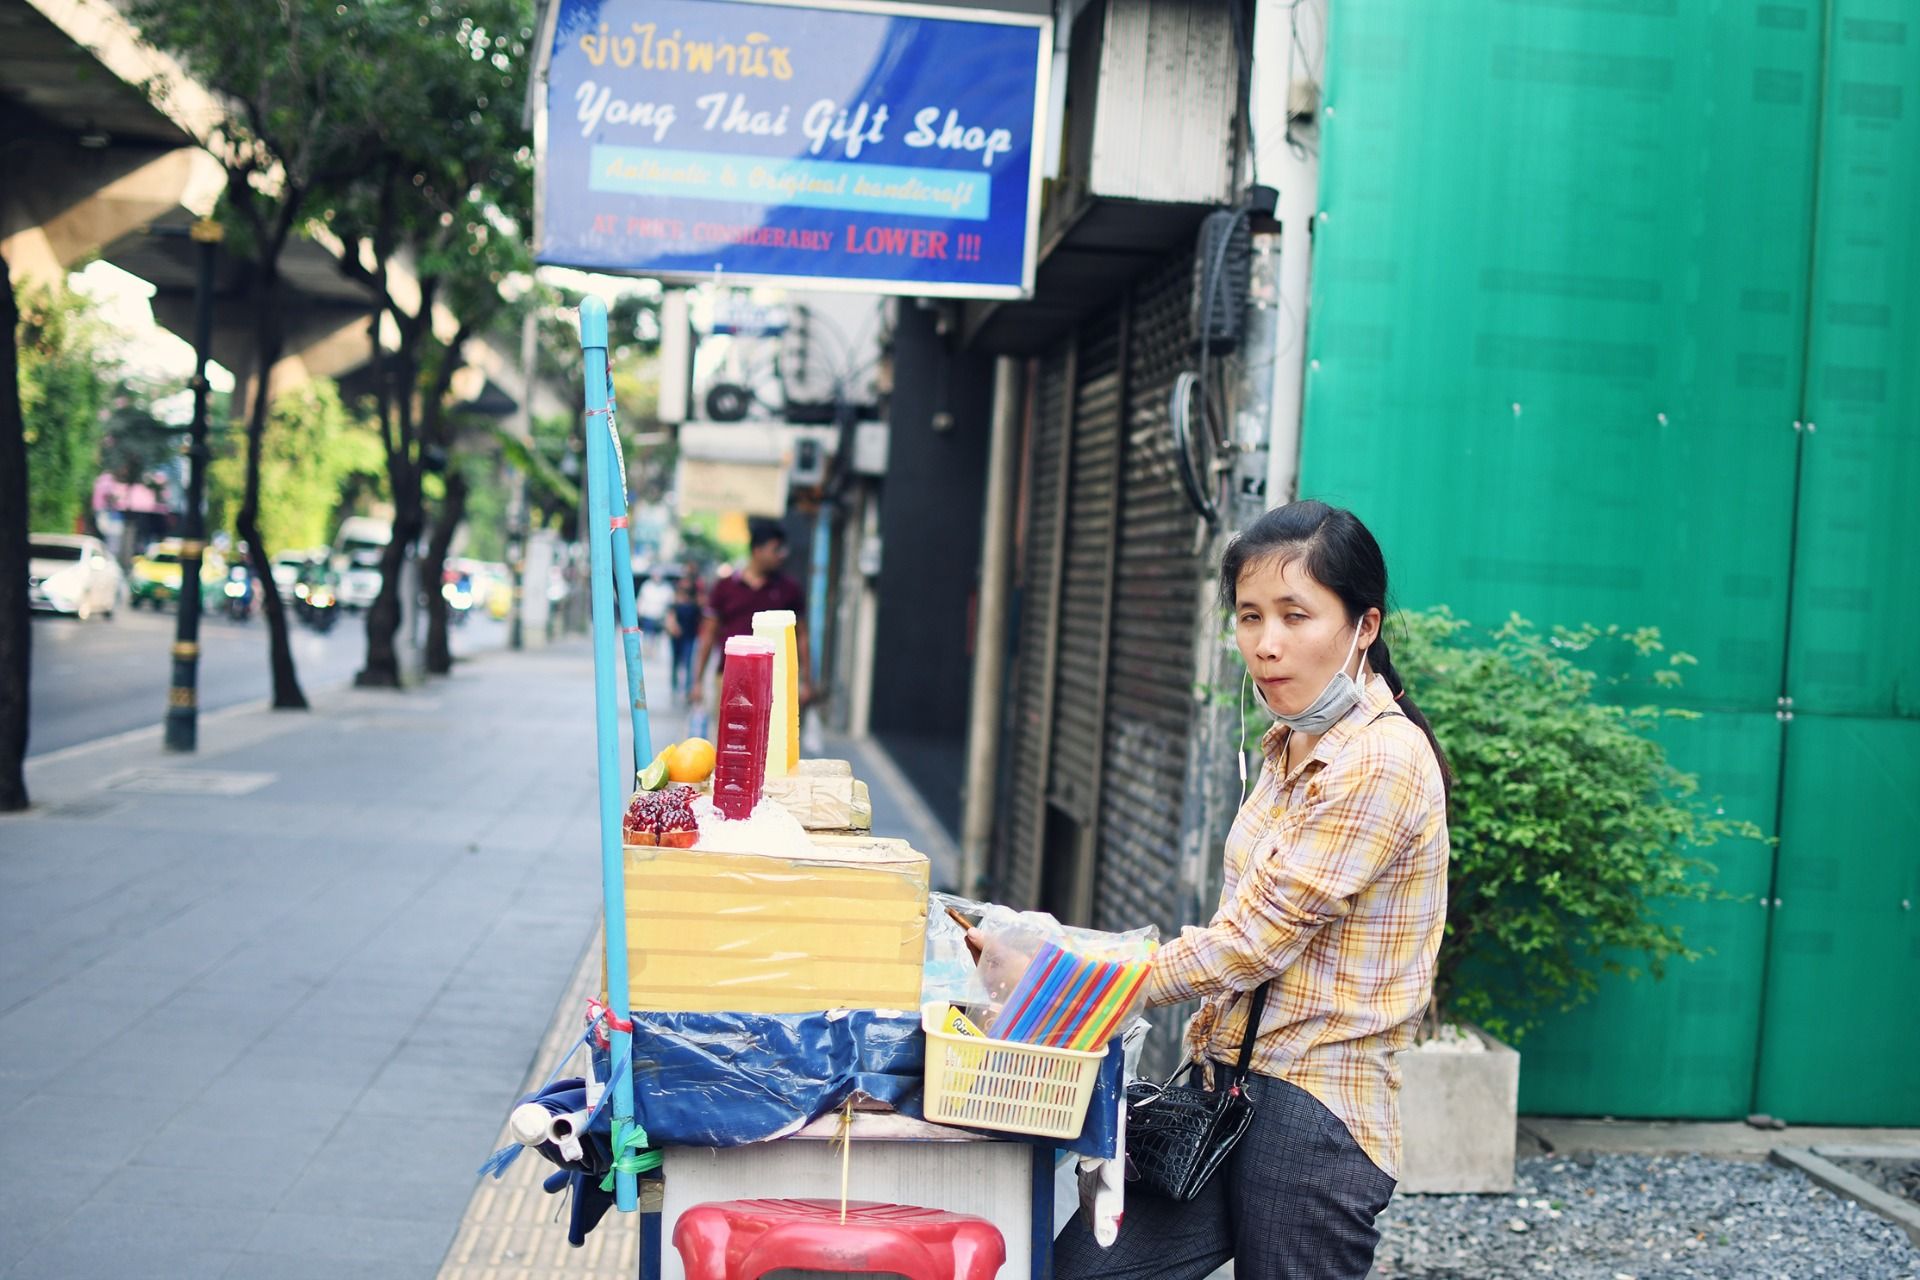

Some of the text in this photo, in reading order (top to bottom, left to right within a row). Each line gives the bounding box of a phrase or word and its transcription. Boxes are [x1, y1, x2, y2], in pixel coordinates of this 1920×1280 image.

[575, 80, 1012, 167] Yong Thai Gift Shop
[749, 166, 847, 199] Original
[853, 176, 976, 211] handicraft
[692, 221, 833, 251] CONSIDERABLY
[846, 224, 948, 260] LOWER
[957, 233, 981, 261] !!!
